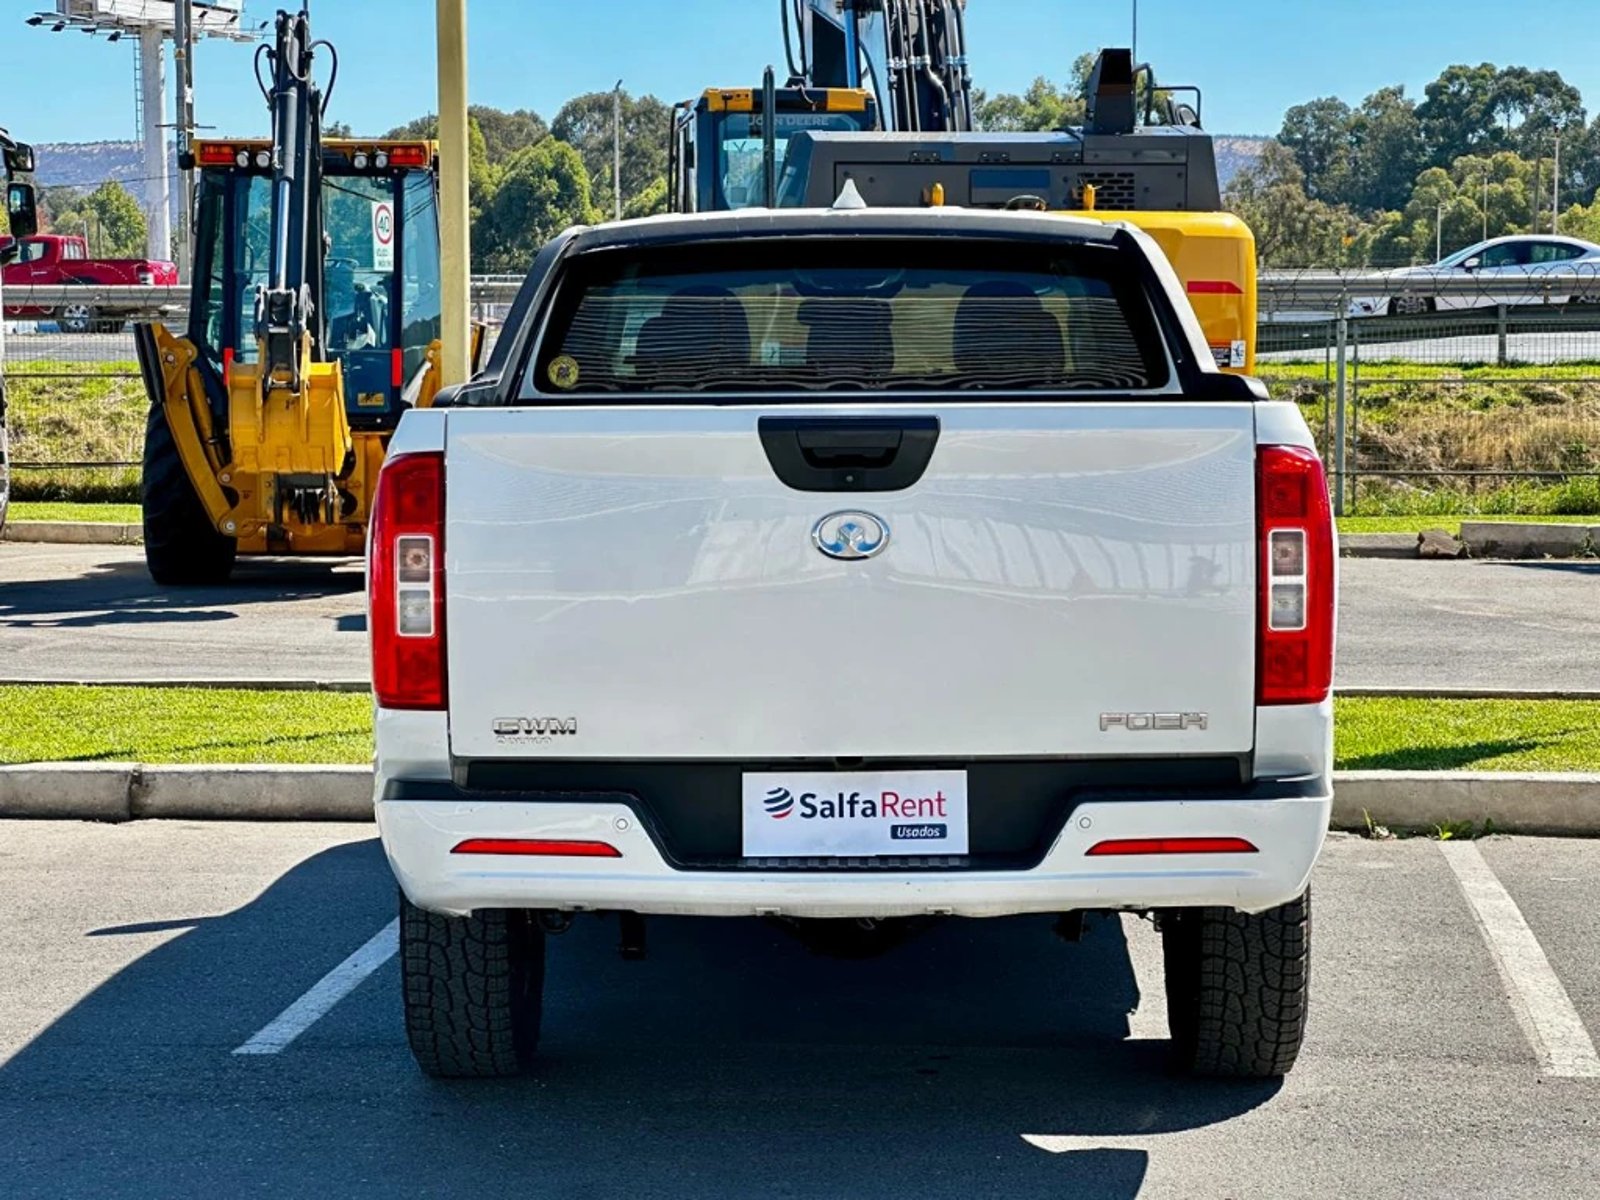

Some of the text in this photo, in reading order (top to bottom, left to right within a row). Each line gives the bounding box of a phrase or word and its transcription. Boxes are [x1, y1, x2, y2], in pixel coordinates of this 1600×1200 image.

[748, 115, 829, 126] JON DEERE
[492, 717, 577, 735] GWM
[1099, 712, 1208, 731] POER
[799, 791, 948, 819] SalfaRent
[896, 825, 941, 838] Usados
